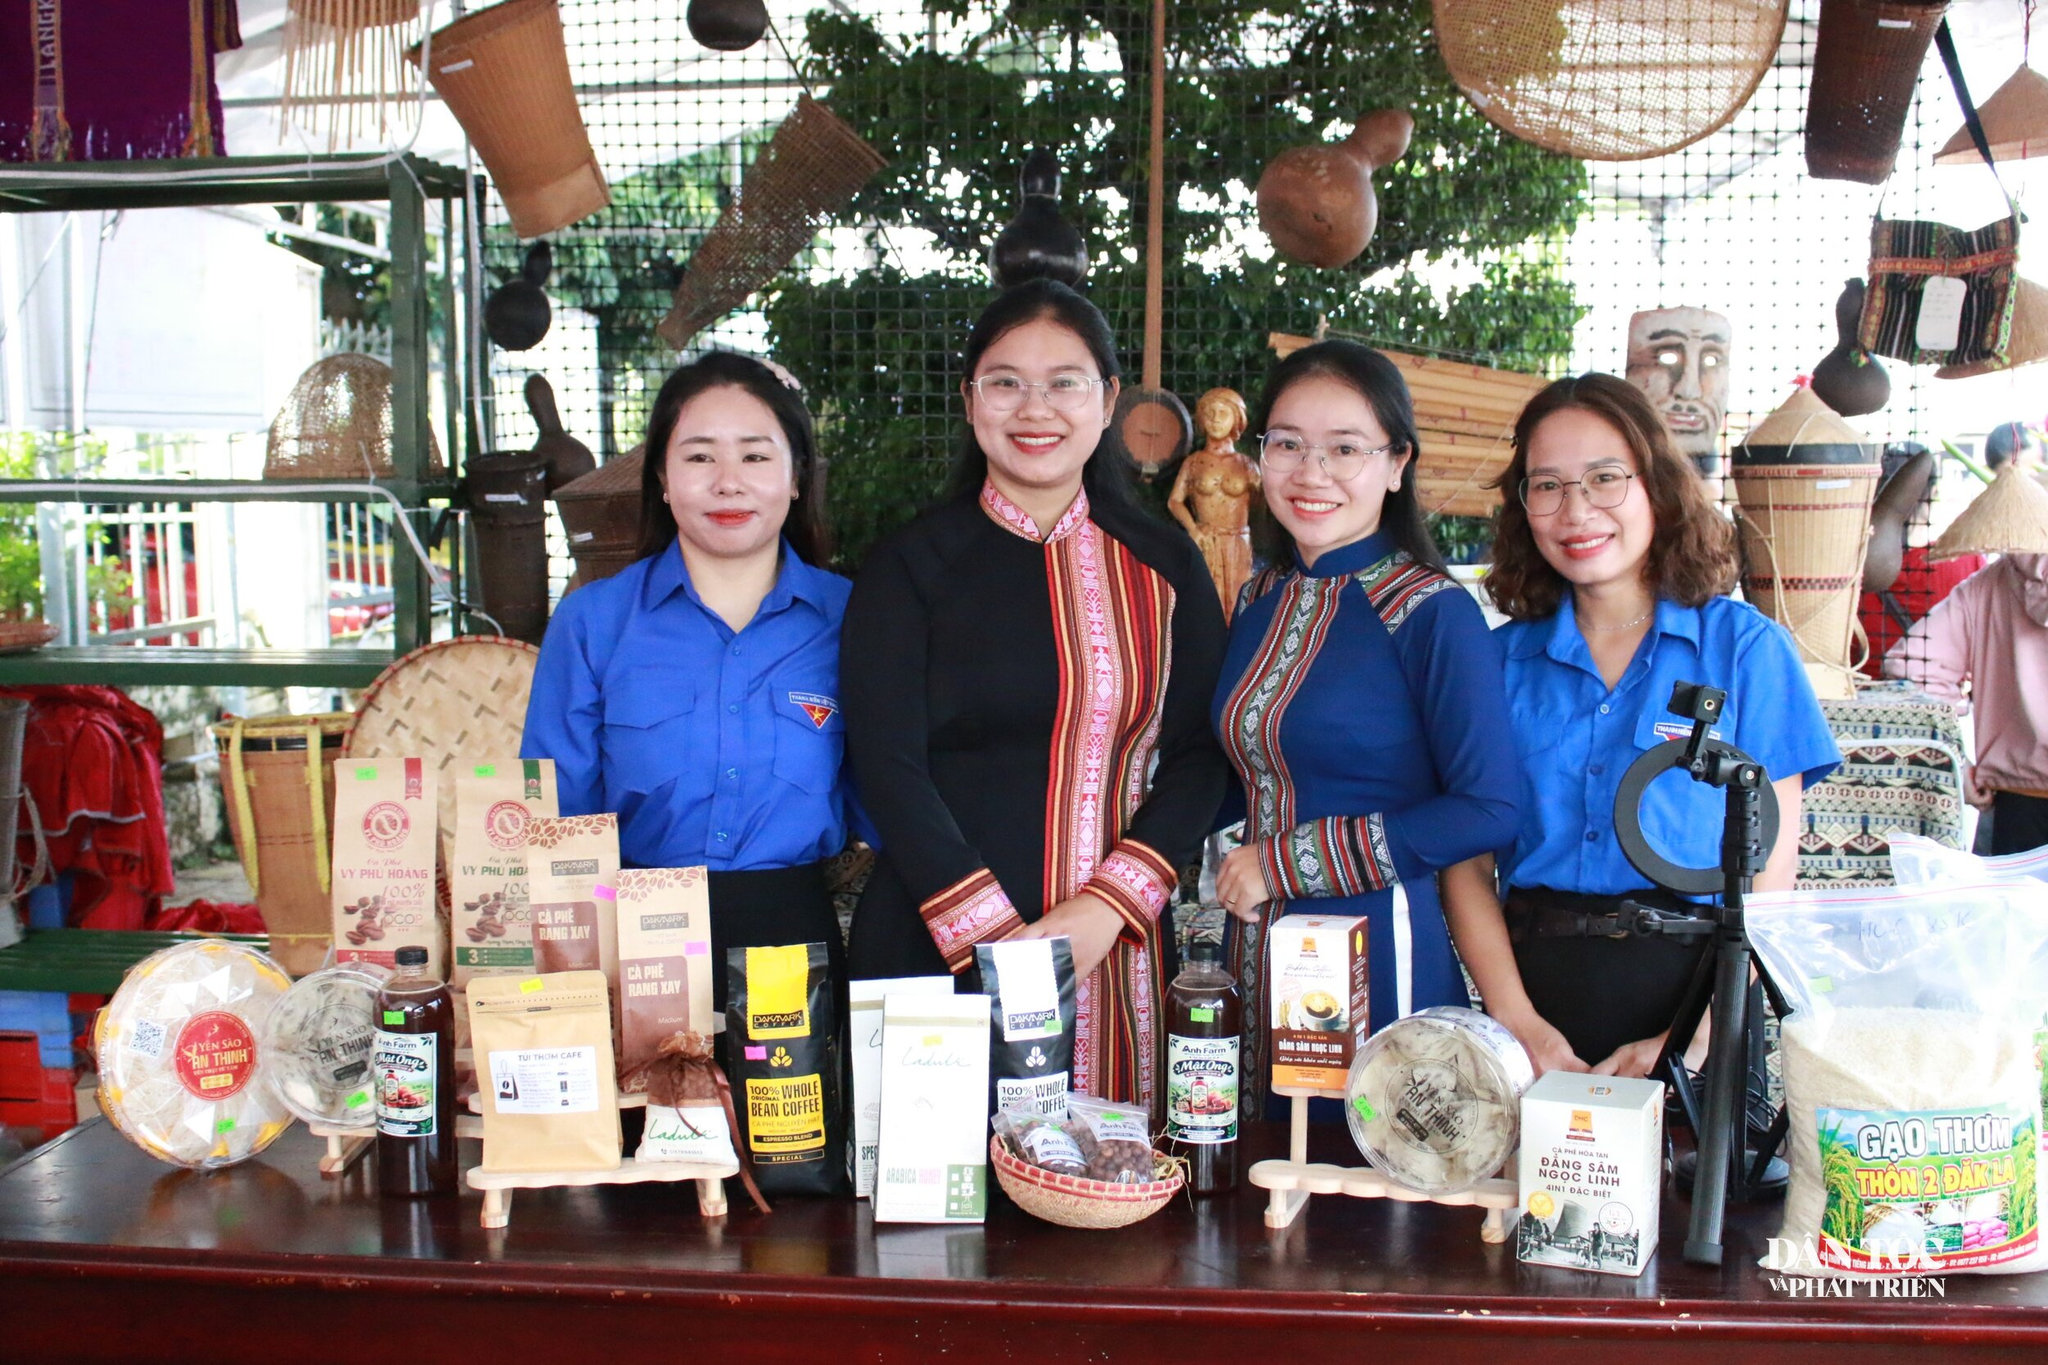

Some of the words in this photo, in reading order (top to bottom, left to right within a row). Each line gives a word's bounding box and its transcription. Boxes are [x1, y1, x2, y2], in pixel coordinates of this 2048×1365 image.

[340, 868, 357, 879] VY
[461, 866, 478, 876] VY
[539, 926, 568, 941] RANG
[571, 925, 590, 940] XAY
[468, 949, 479, 964] 3
[627, 963, 642, 980] CÀ
[643, 962, 665, 979] PHÊ
[628, 981, 659, 997] RANG
[661, 980, 681, 995] XAY
[753, 1011, 804, 1023] DAKMARK
[1009, 1009, 1055, 1024] DAKMARK
[393, 1038, 418, 1049] Farm
[1182, 1045, 1202, 1054] Anh
[1203, 1046, 1227, 1055] Farm
[561, 1051, 583, 1060] CAFE
[1205, 1060, 1228, 1074] Ong
[749, 1085, 780, 1096] 100%
[781, 1080, 819, 1099] WHOLE
[1001, 1086, 1034, 1096] 100%
[1035, 1077, 1066, 1099] WHOLE
[751, 1101, 779, 1117] BEAN
[782, 1097, 820, 1117] COFFEE
[1858, 1118, 1927, 1162] GẠO
[1933, 1113, 2012, 1156] THƠM
[771, 1153, 803, 1162] SPECIAL
[1596, 1151, 1609, 1159] TAN
[1587, 1161, 1619, 1175] SÂM
[885, 1167, 917, 1185] ARABICA
[1538, 1168, 1582, 1184] NGỌC
[1588, 1174, 1621, 1187] LINH
[1855, 1163, 1919, 1198] THÔN
[1922, 1167, 1939, 1197] 2
[1942, 1158, 1990, 1194] ĐĂK
[1991, 1156, 2017, 1185] LA
[1545, 1184, 1566, 1193] 4IN1
